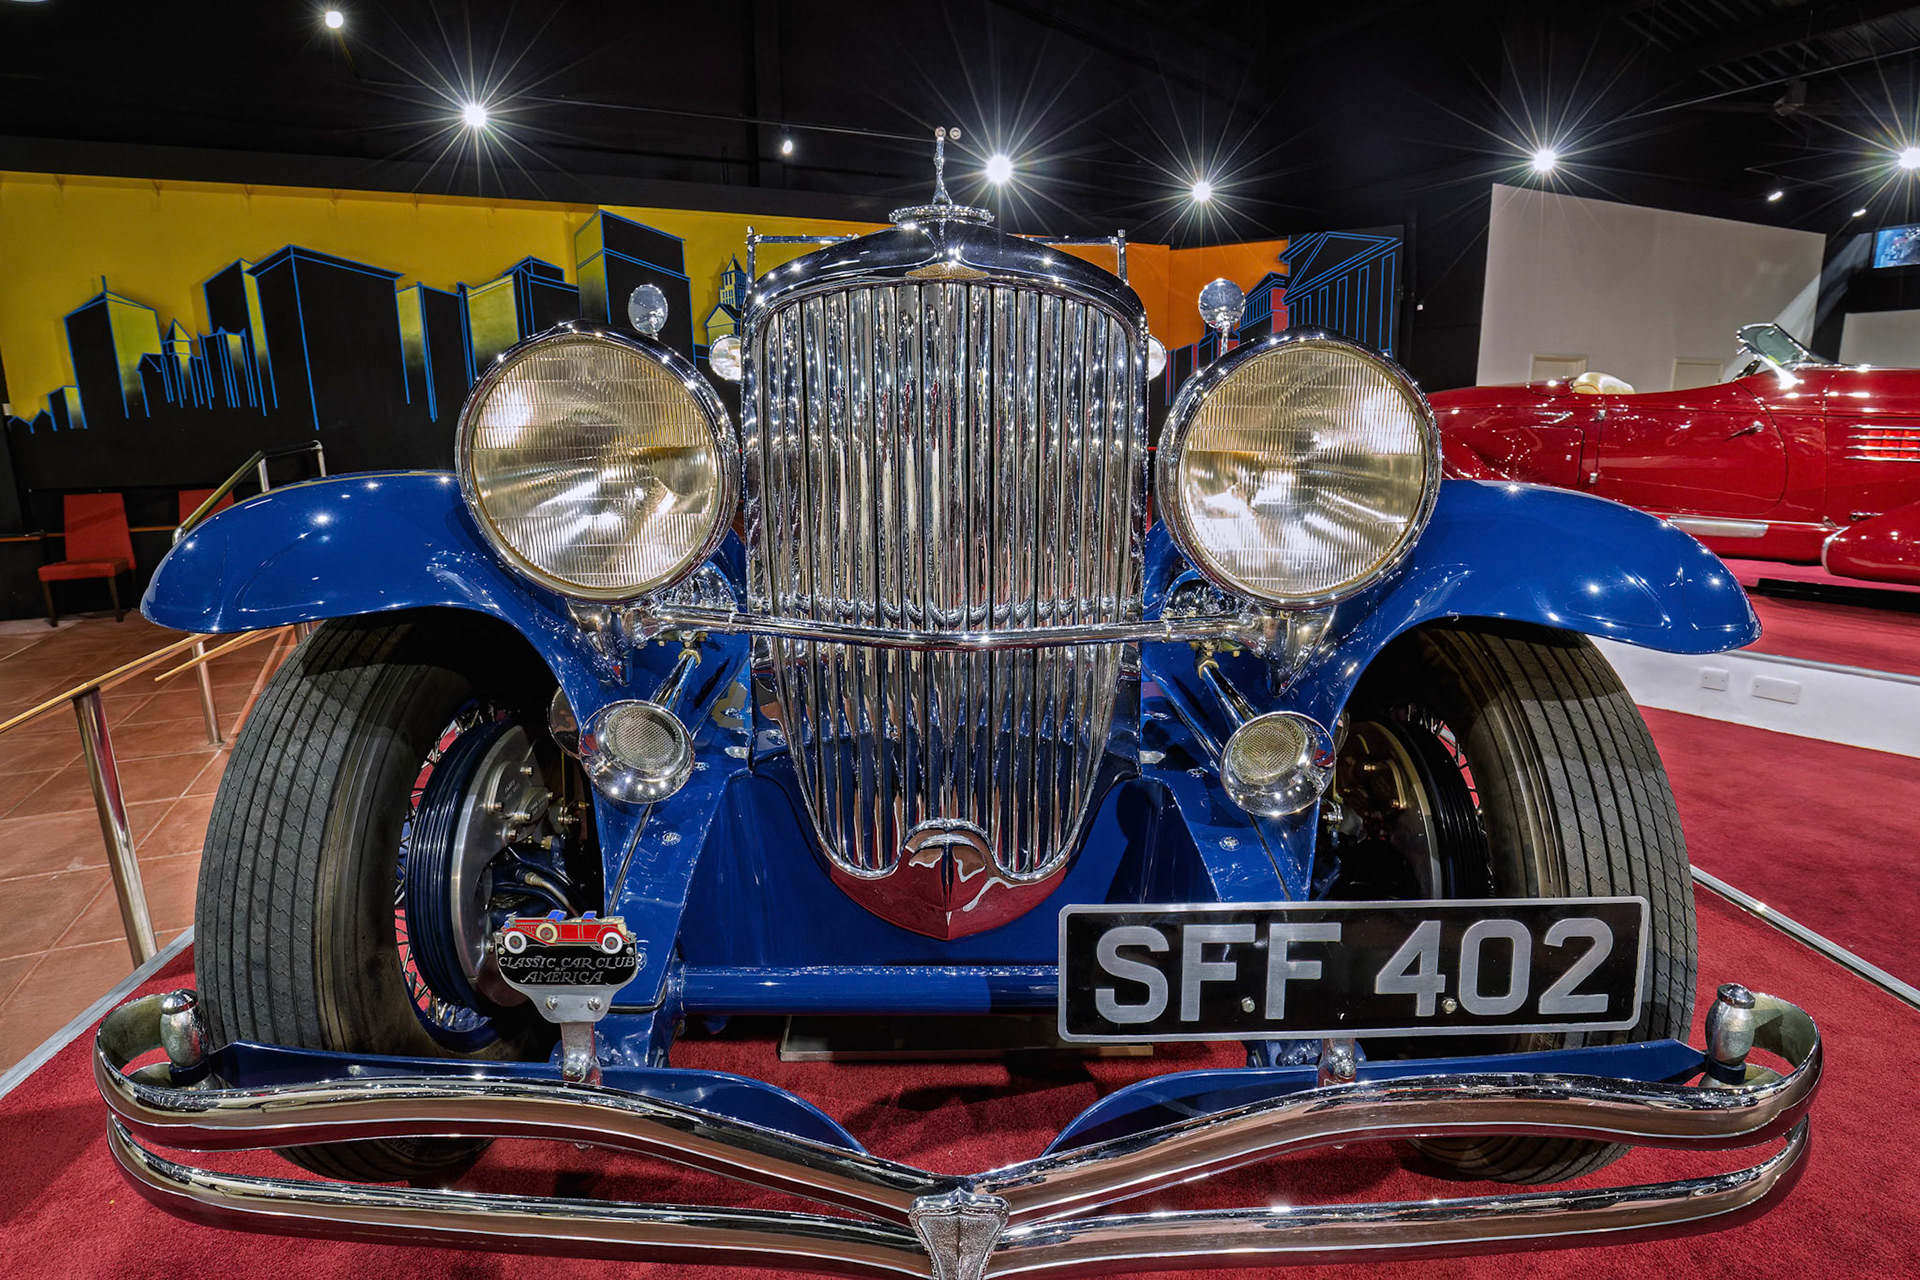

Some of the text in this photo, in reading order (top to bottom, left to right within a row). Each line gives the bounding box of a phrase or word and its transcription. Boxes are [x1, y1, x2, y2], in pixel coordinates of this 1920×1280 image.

[499, 956, 635, 970] CLASSIC CAR CLUB
[520, 971, 604, 984] AMERICA
[1096, 917, 1613, 1024] SFF 402
